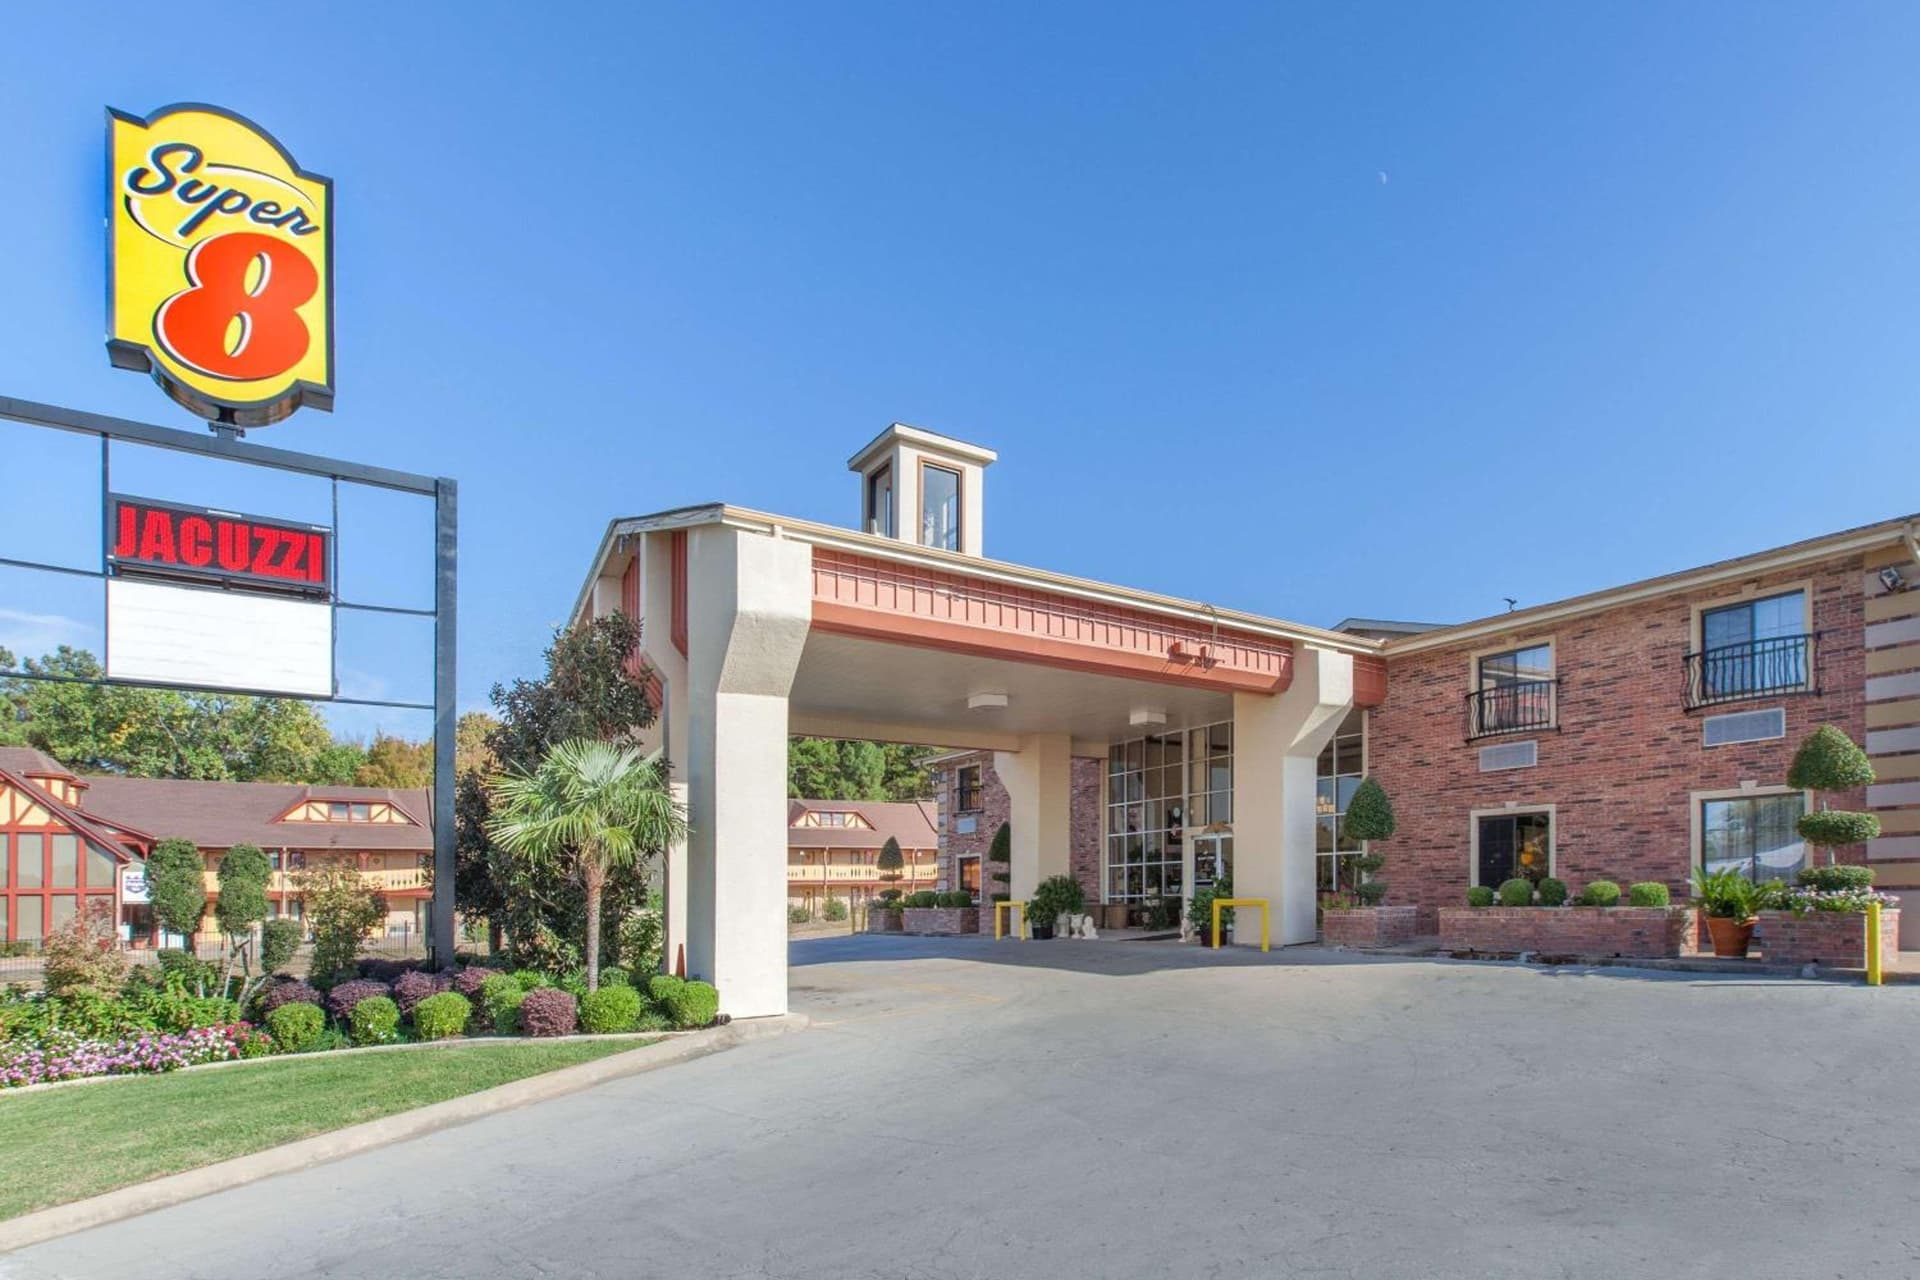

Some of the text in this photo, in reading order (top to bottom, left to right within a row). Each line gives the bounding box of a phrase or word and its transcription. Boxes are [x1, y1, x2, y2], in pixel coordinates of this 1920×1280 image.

[126, 143, 320, 238] Super
[152, 232, 319, 382] 8
[114, 504, 323, 583] JACUZZI
